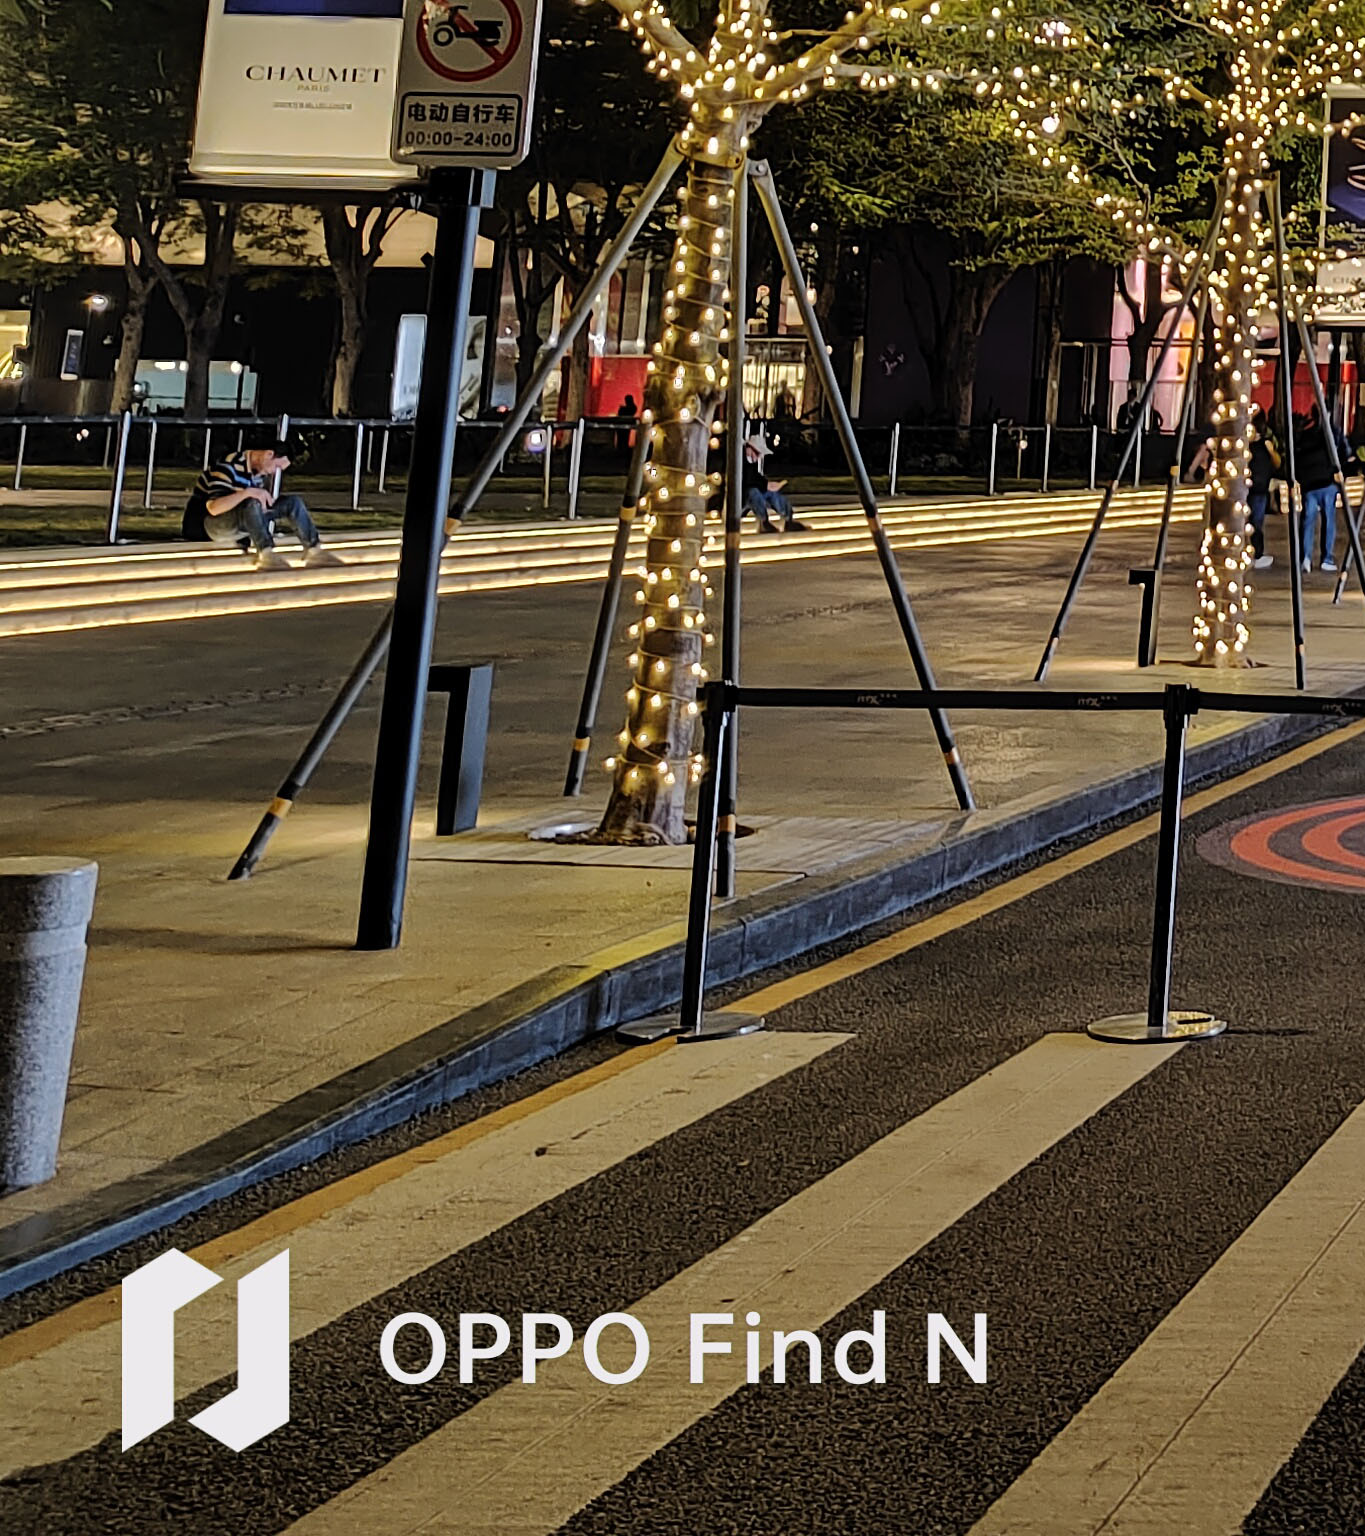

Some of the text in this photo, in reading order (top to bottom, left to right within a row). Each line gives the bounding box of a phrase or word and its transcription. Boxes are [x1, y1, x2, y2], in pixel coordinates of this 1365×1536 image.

[245, 64, 386, 83] CHAUMET
[297, 84, 331, 93] PARIS
[407, 102, 515, 124] 电动自行车
[405, 131, 512, 147] 00:00-24:00
